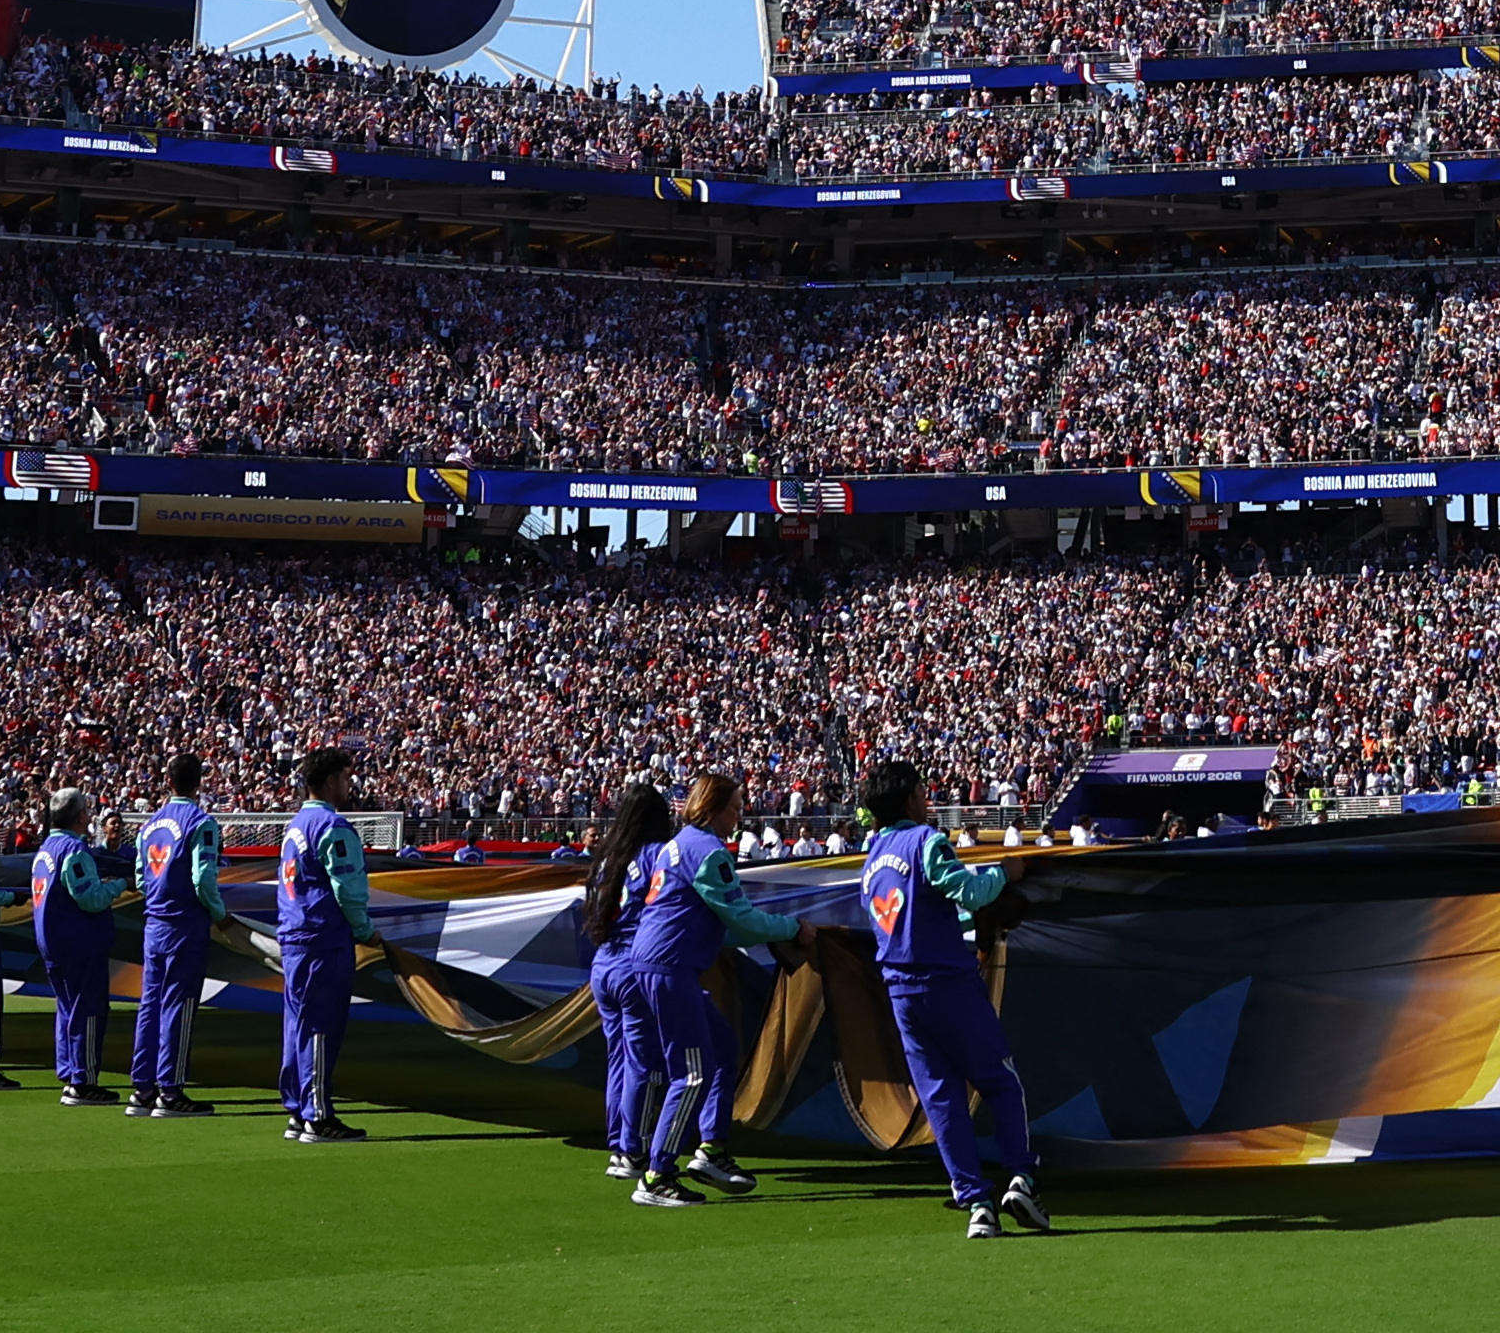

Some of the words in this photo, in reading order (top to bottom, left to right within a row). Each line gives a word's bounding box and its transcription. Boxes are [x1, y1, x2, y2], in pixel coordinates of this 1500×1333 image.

[1294, 60, 1306, 69] USA
[492, 171, 505, 180] USA
[1222, 176, 1235, 186] USA
[245, 472, 266, 486] USA
[1304, 476, 1342, 490] BOSNIA
[1344, 475, 1365, 489] AND
[1368, 473, 1436, 488] HERZEGOVINA
[570, 483, 607, 498] BOSNIA
[609, 485, 629, 499] AND
[632, 485, 696, 501] HERZEGOVINA
[986, 486, 1006, 500] USA
[156, 510, 196, 521] SAN
[200, 511, 311, 525] FRANCISCO
[316, 515, 351, 526] BAY
[356, 517, 405, 528] AREA
[1127, 774, 1148, 783] FIFA
[1150, 774, 1184, 783] WORLD
[1187, 773, 1206, 782] CUP
[1207, 771, 1242, 781] 2026
